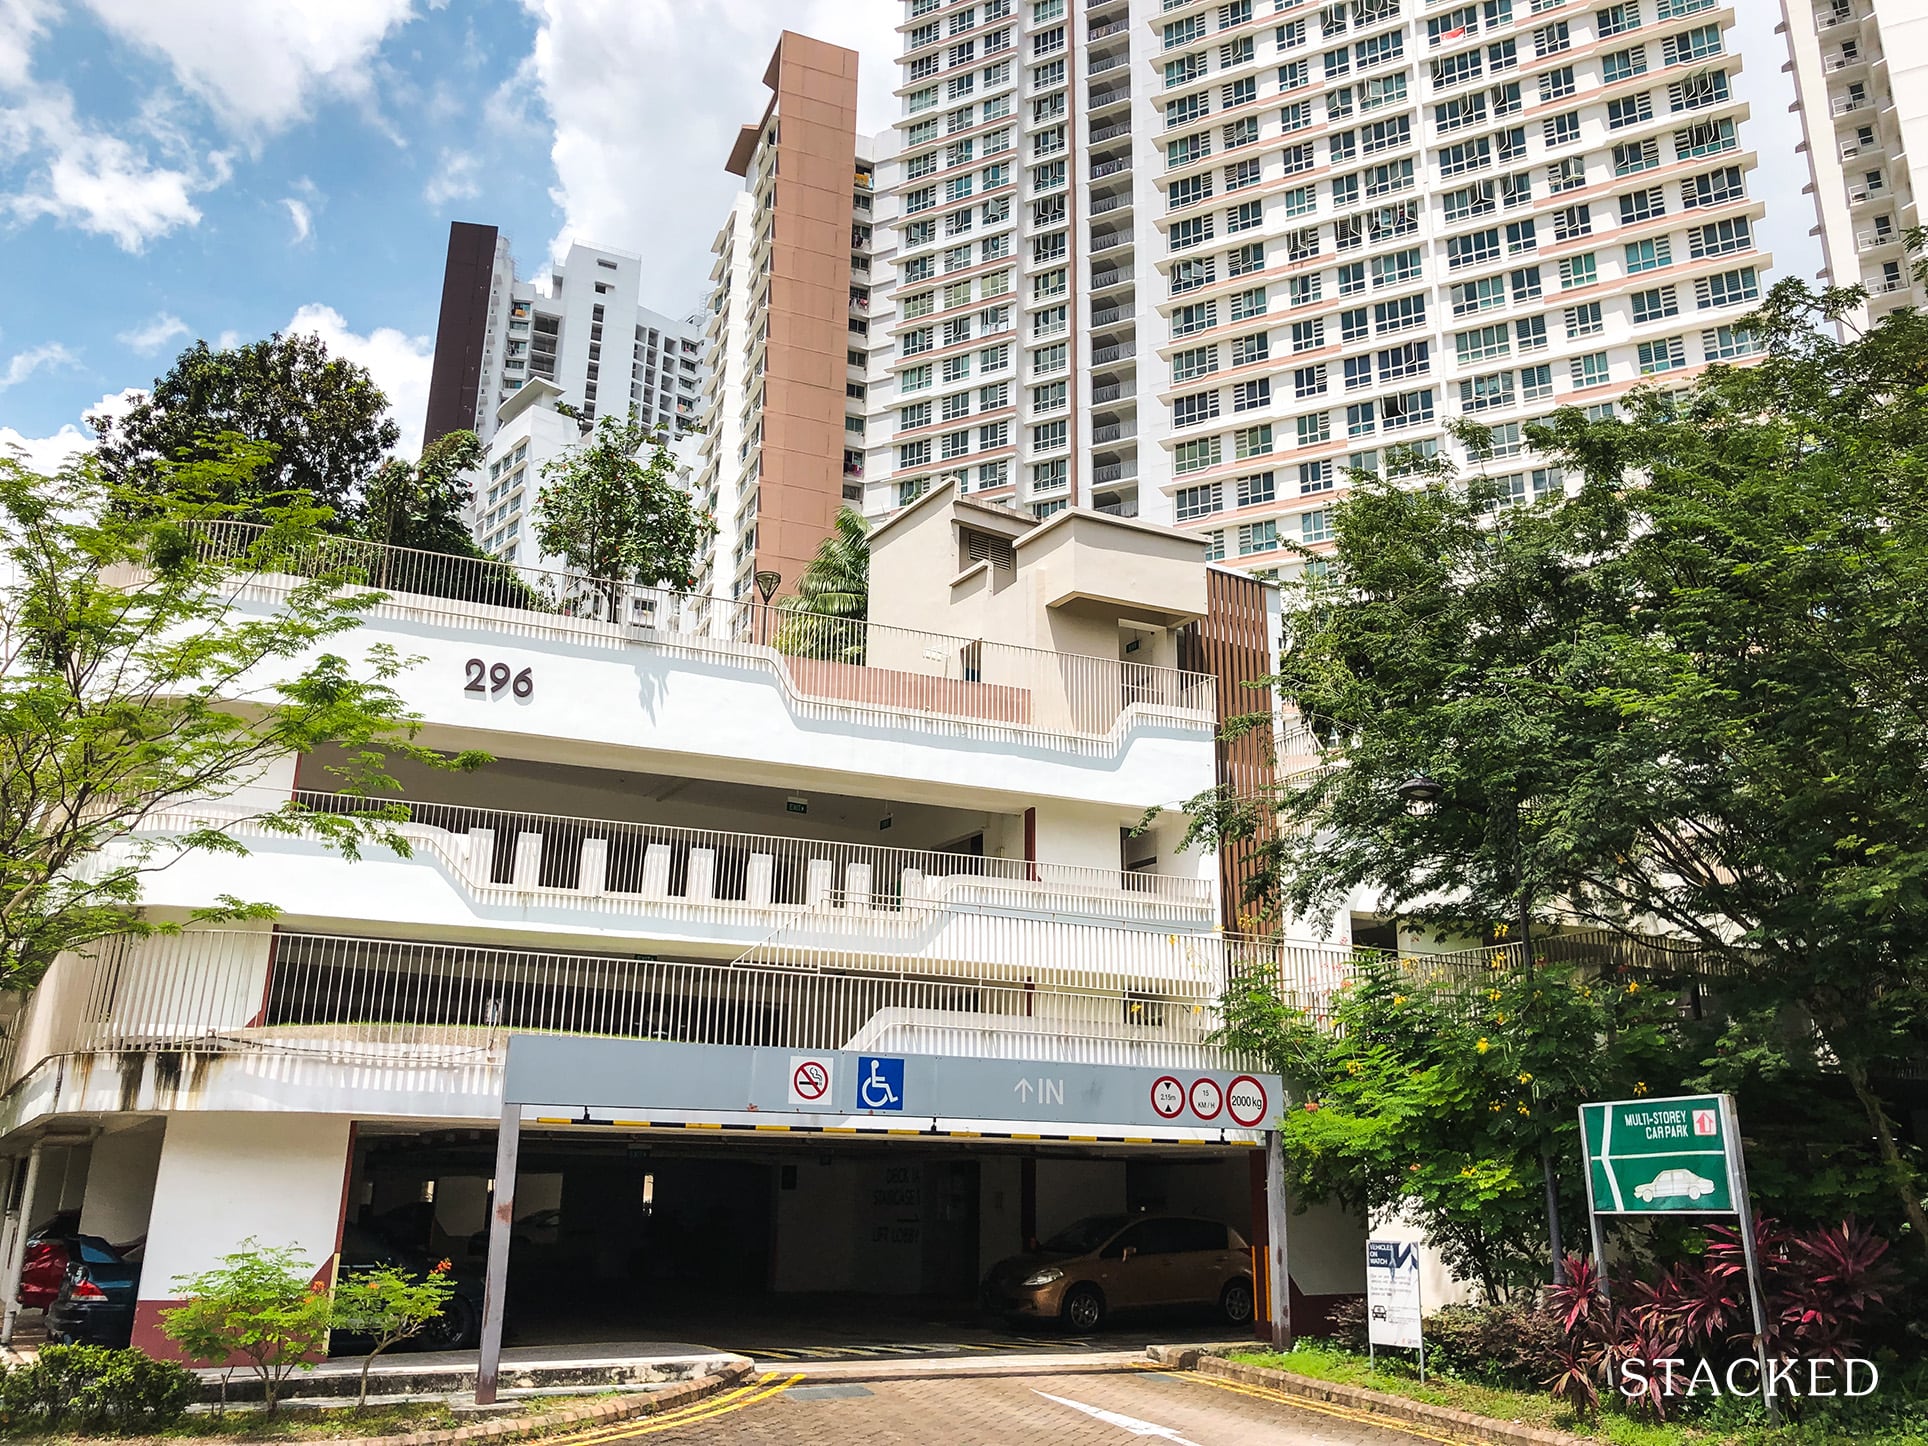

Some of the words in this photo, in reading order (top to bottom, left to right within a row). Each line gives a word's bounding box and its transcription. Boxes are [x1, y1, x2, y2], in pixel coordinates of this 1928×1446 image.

[463, 658, 533, 698] 296
[1038, 1078, 1064, 1105] IN
[1624, 1110, 1687, 1127] MULTI-STOREY
[1645, 1126, 1666, 1140] CAR
[1666, 1124, 1689, 1138] PARK
